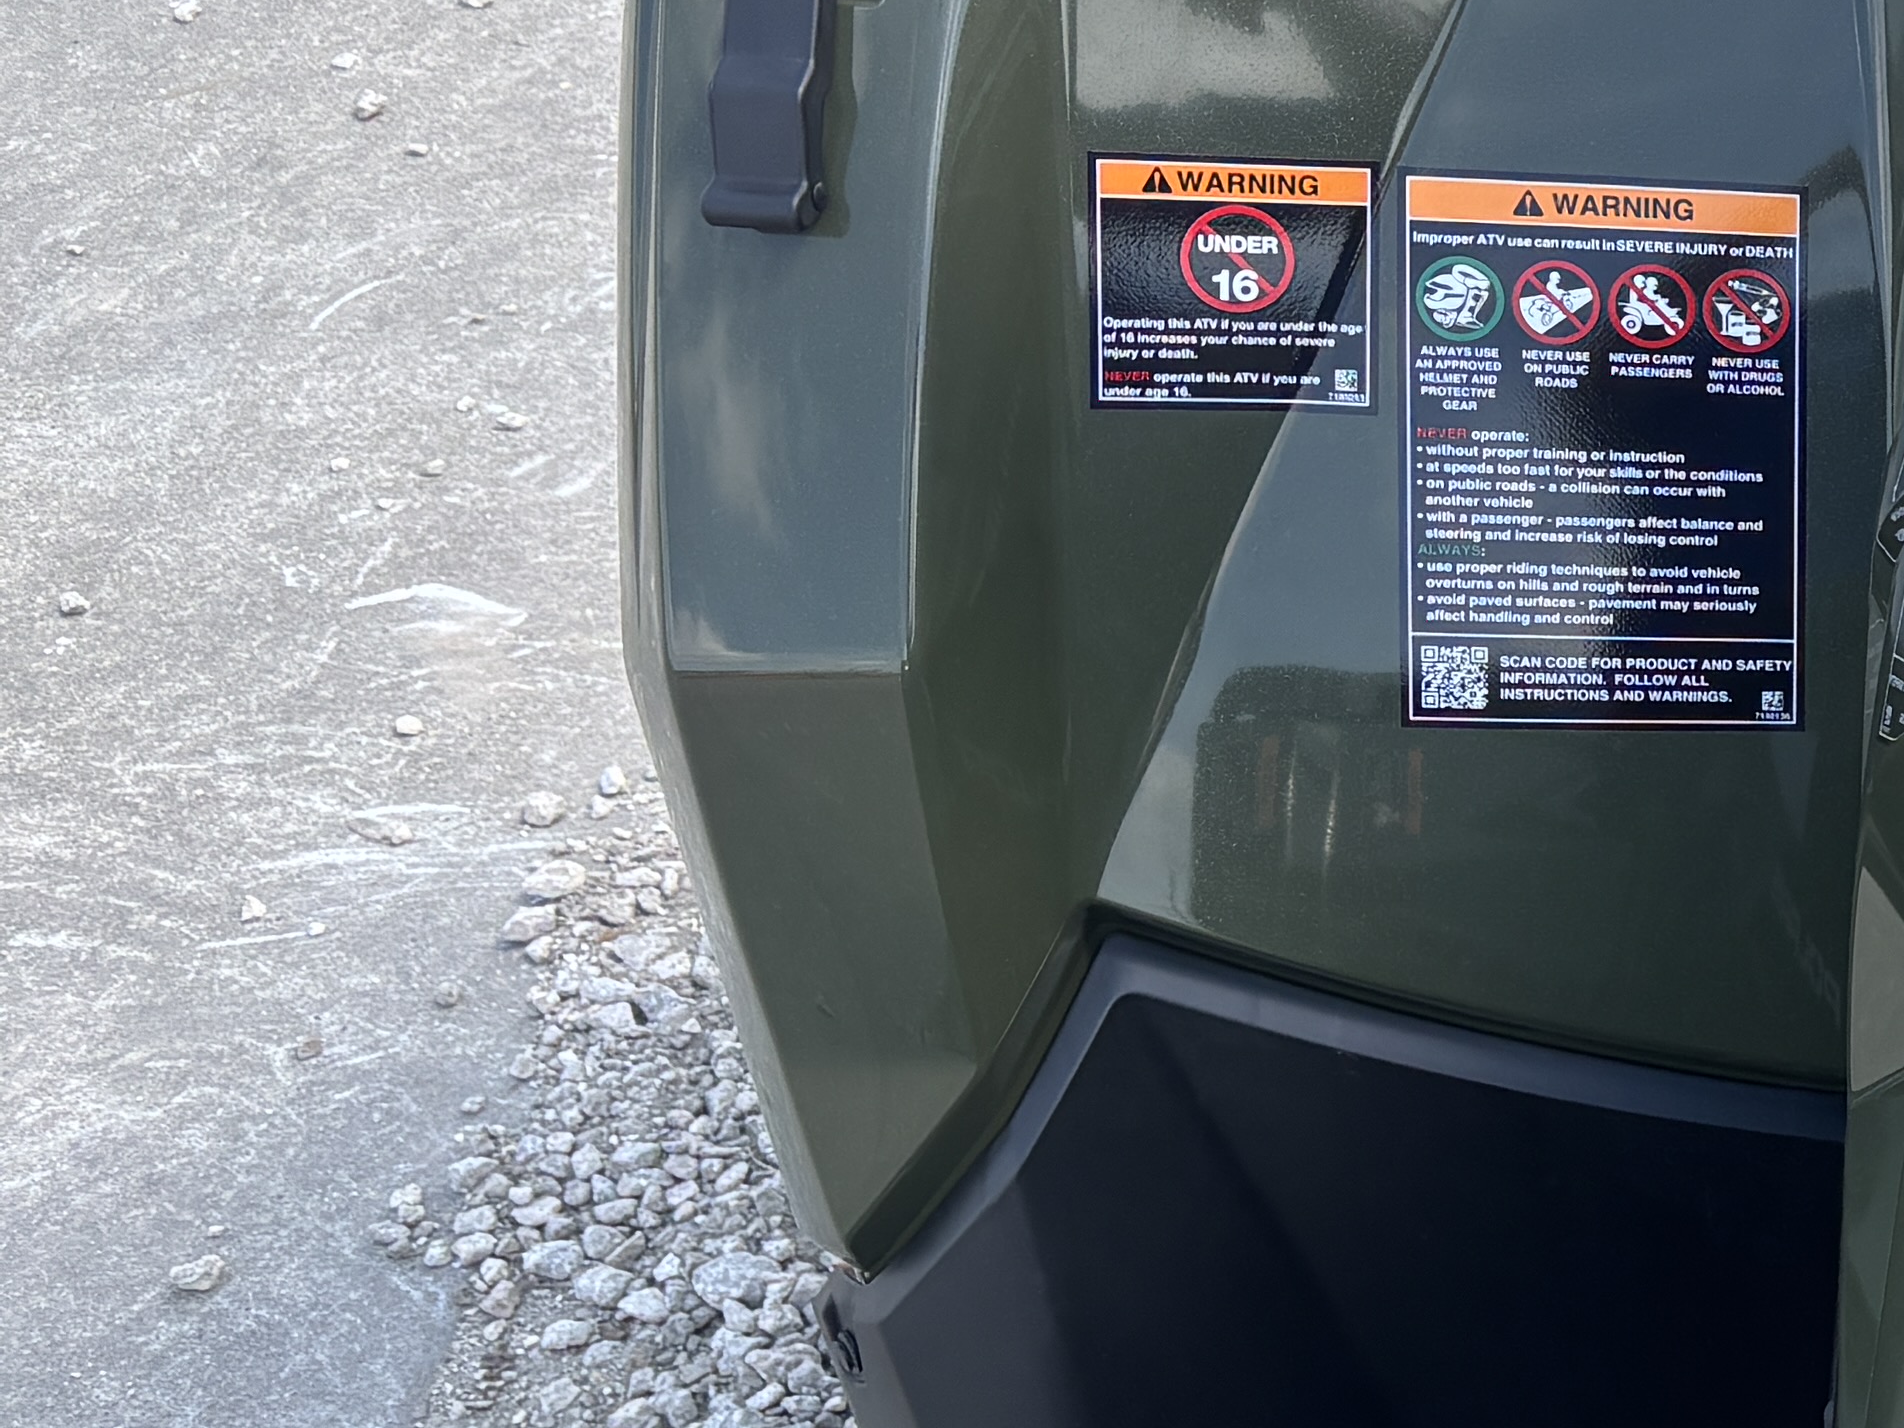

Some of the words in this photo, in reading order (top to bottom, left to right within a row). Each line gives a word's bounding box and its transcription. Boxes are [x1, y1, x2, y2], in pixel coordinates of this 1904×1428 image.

[1176, 170, 1319, 196] WARNING
[1552, 192, 1694, 222] WARNING
[1197, 233, 1279, 255] UNDER
[1412, 230, 1475, 247] Improper
[1476, 233, 1505, 246] ATV
[1507, 237, 1533, 248] use
[1533, 238, 1560, 249] can
[1560, 238, 1600, 251] result
[1602, 238, 1616, 251] in
[1616, 239, 1674, 254] SEVERE
[1675, 242, 1728, 256] INJURY
[1729, 247, 1744, 257] or
[1745, 245, 1794, 259] DEATH
[1211, 269, 1259, 302] 16
[1103, 316, 1165, 331] Operating
[1167, 317, 1192, 330] this
[1193, 318, 1218, 330] ATV
[1220, 318, 1230, 330] if
[1231, 321, 1255, 333] you
[1257, 321, 1277, 331] are
[1279, 320, 1316, 332] under
[1318, 321, 1339, 333] the
[1340, 324, 1364, 336] age
[1103, 331, 1117, 343] of
[1120, 331, 1135, 343] 16
[1137, 331, 1198, 345] increases
[1200, 335, 1229, 347] your
[1231, 334, 1277, 346] chance
[1279, 334, 1292, 346] of
[1294, 337, 1336, 348] severe
[1103, 346, 1139, 361] injury
[1141, 349, 1156, 359] or
[1157, 347, 1199, 359] death.
[1420, 345, 1472, 357] ALWAYS
[1474, 347, 1500, 359] USE
[1521, 349, 1564, 361] NEVER
[1565, 351, 1591, 362] USE
[1608, 352, 1650, 364] NEVER
[1652, 354, 1695, 366] CARRY
[1414, 358, 1433, 369] AN
[1435, 359, 1502, 372] APPROVED
[1523, 362, 1543, 374] ON
[1544, 363, 1589, 376] PUBLIC
[1711, 356, 1753, 369] NEVER
[1755, 358, 1780, 370] USE
[1104, 371, 1150, 382] NEVER
[1153, 372, 1204, 385] operate
[1206, 371, 1231, 383] this
[1233, 372, 1259, 384] ATV
[1261, 372, 1271, 384] if
[1272, 374, 1297, 387] you
[1300, 375, 1321, 385] are
[1419, 372, 1468, 384] HELMET
[1471, 374, 1498, 385] AND
[1610, 365, 1693, 379] PASSENGERS
[1707, 369, 1739, 381] WITH
[1741, 371, 1784, 383] DRUGS
[1534, 376, 1578, 389] ROADS
[1706, 382, 1725, 394] OR
[1727, 383, 1785, 396] ALCOHOL
[1102, 385, 1144, 399] under
[1142, 387, 1171, 399] age
[1170, 386, 1194, 399] 16.
[1420, 385, 1496, 399] PROTECTIVE
[1442, 399, 1478, 411] GEAR
[1417, 427, 1467, 439] NEVER
[1471, 430, 1530, 443] operate:
[1425, 443, 1479, 457] without
[1482, 447, 1530, 461] proper
[1532, 447, 1588, 464] training
[1590, 451, 1606, 461] or
[1609, 449, 1685, 464] instruction
[1425, 494, 1481, 507] another
[1483, 495, 1534, 509] vehicle
[1425, 527, 1482, 543] steering
[1484, 529, 1512, 541] and
[1514, 529, 1574, 543] increase
[1576, 530, 1603, 544] risk
[1605, 531, 1621, 544] of
[1623, 532, 1666, 548] losing
[1668, 534, 1718, 547] control
[1426, 610, 1466, 622] affect
[1469, 610, 1531, 627] handling
[1534, 612, 1561, 624] and
[1563, 612, 1614, 625] control
[1499, 655, 1542, 668] SCAN
[1544, 656, 1588, 669] CODE
[1591, 656, 1622, 669] FOR
[1625, 657, 1698, 670] PRODUCT
[1701, 659, 1733, 671] AND
[1736, 659, 1792, 672] SAFETY
[1499, 671, 1607, 685] INFORMATION.
[1614, 673, 1678, 686] FOLLOW
[1681, 674, 1710, 687] ALL
[1500, 688, 1610, 702] INSTRUCTIONS
[1613, 689, 1645, 702] AND
[1647, 690, 1733, 703] WARNINGS.
